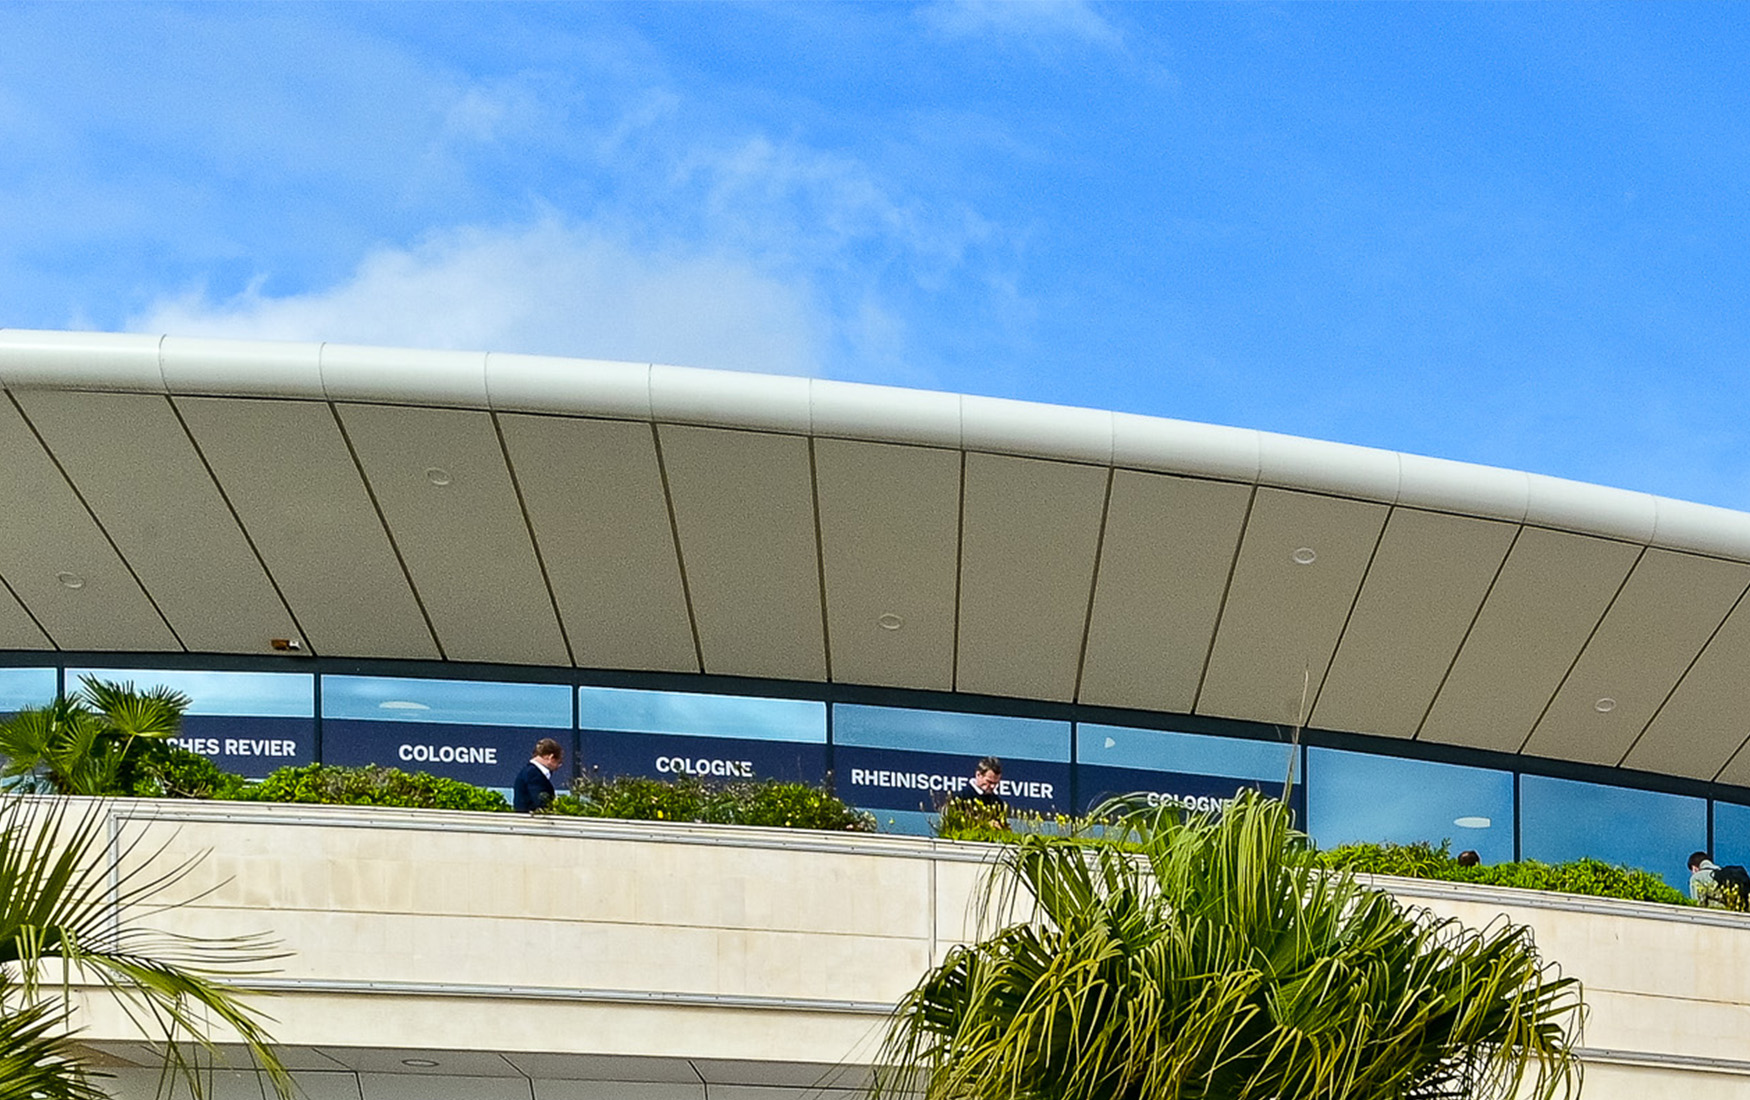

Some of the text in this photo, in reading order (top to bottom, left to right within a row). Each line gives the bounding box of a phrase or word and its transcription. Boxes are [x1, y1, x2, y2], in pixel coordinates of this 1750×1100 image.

[225, 739, 296, 756] REVIER
[398, 744, 497, 764] COLOGNE
[656, 757, 753, 777] COLOGNE
[852, 769, 968, 792] RHEINISCHE
